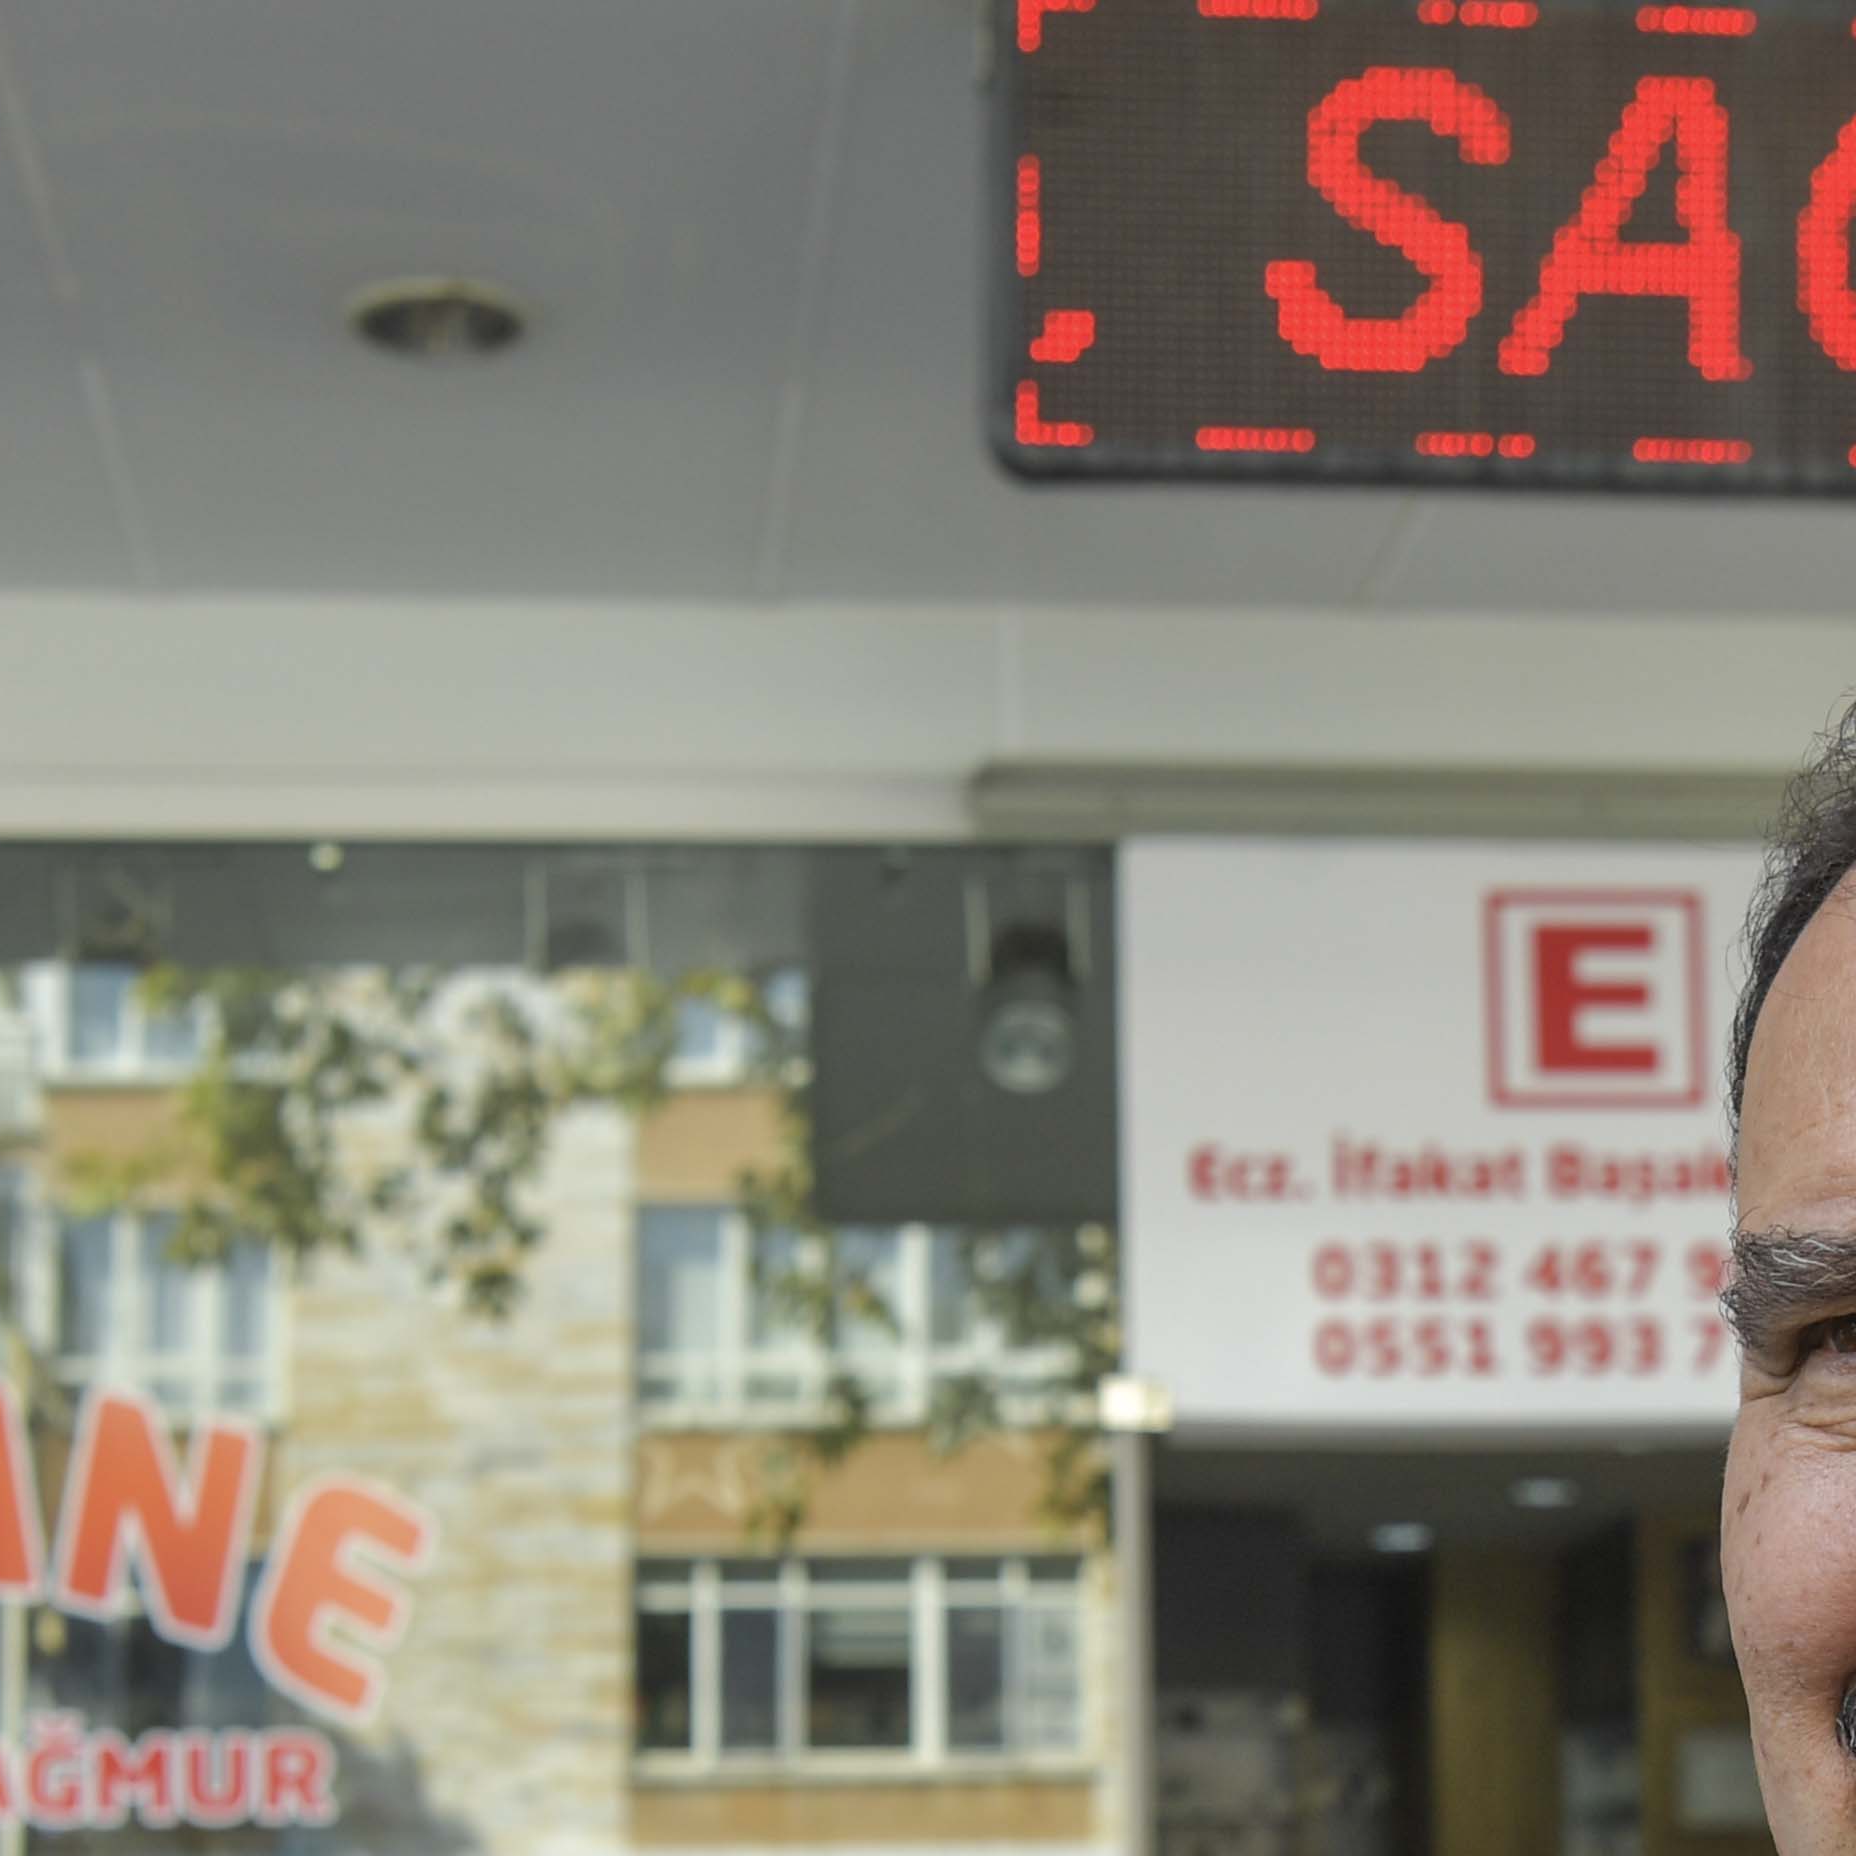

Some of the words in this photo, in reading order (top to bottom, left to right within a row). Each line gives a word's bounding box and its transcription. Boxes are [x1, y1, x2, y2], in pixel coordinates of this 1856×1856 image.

[1531, 922, 1660, 1075] E
[1311, 1241, 1499, 1300] 0312
[1525, 1243, 1661, 1299] 467
[1684, 1243, 1730, 1299] 9
[1311, 1317, 1497, 1376] 0551
[1528, 1317, 1666, 1377] 993
[1689, 1318, 1726, 1375] 7
